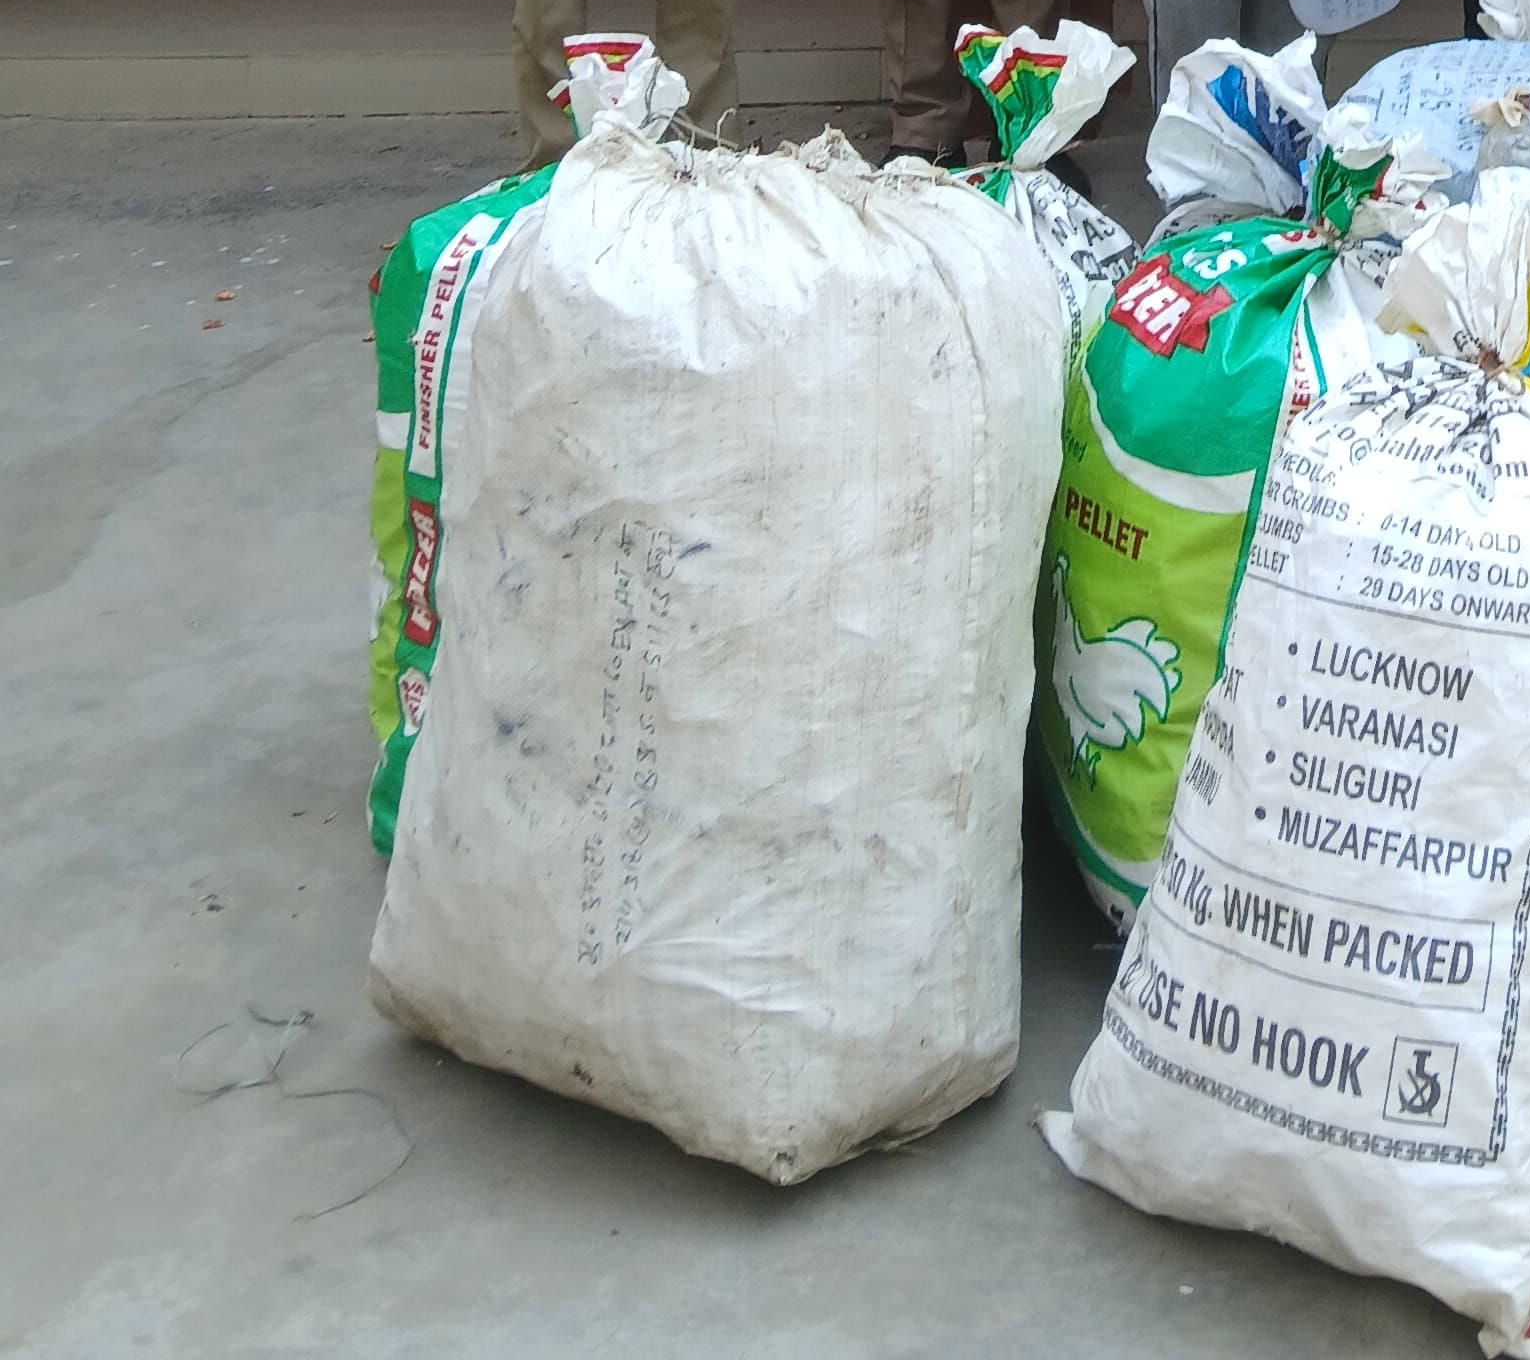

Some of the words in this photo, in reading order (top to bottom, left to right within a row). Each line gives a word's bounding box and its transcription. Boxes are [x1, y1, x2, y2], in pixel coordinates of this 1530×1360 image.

[418, 329, 441, 450] FINISHER
[430, 232, 478, 320] PELLET
[1064, 485, 1150, 561] PELLET
[1380, 511, 1421, 539] 0-14
[1480, 532, 1521, 555] OLD
[1358, 576, 1385, 599] 29
[1388, 580, 1445, 613] DAYS
[1370, 542, 1423, 575] 15-28
[1428, 556, 1481, 583] DAYS
[1487, 562, 1529, 590] OLD
[1311, 638, 1474, 702] LUCKNOW
[1301, 693, 1459, 760] VARANASI
[1290, 751, 1422, 812] SILIGURI
[1277, 804, 1513, 884] MUZAFFARPUR
[1222, 882, 1316, 959] WHEN
[1323, 917, 1475, 986] PACKED
[1138, 960, 1186, 1033] USE
[1188, 991, 1241, 1056] NO
[1251, 1015, 1372, 1098] HOOK
